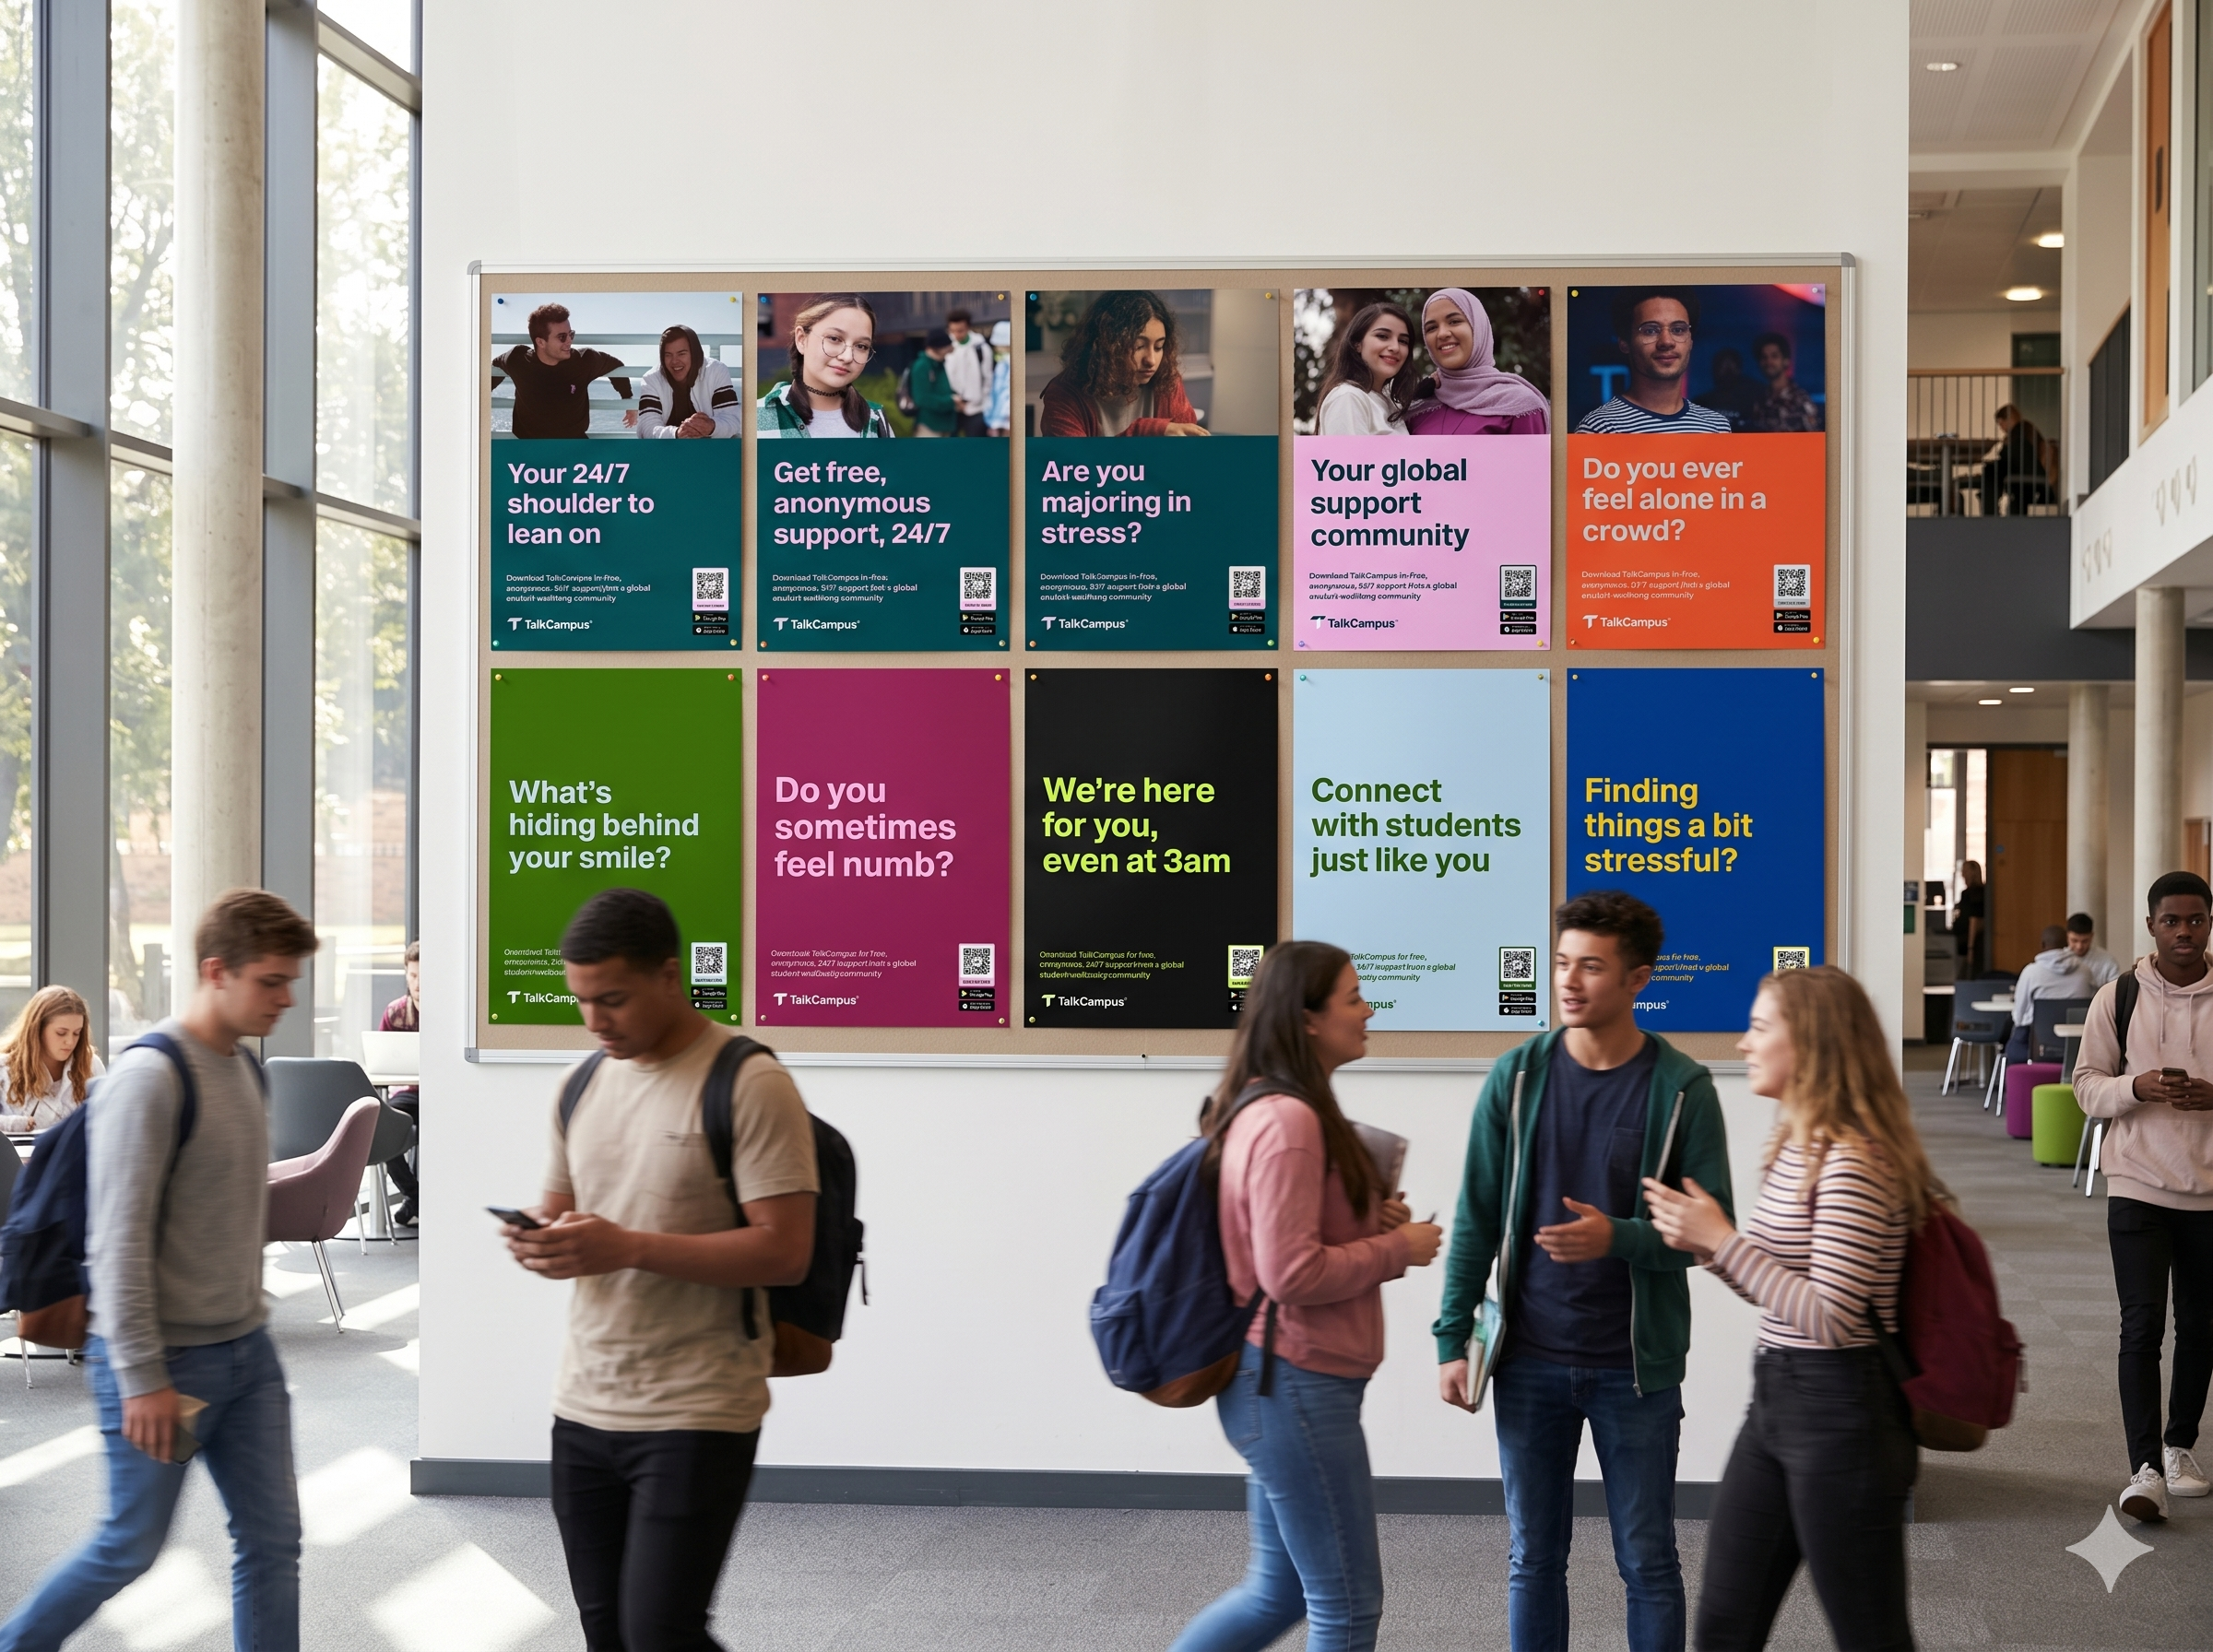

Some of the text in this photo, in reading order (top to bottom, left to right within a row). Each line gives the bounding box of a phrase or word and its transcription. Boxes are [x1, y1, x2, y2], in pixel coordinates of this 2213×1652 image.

[507, 463, 630, 484] Your 24/7
[775, 461, 886, 487] Get free,
[1042, 461, 1144, 488] Are you
[1311, 458, 1466, 487] Your global
[1584, 457, 1743, 485] Do you ever
[508, 493, 654, 513] shoulder to
[774, 497, 930, 519] anonymous
[1043, 490, 1190, 518] majoring in
[1310, 492, 1421, 519] support
[1582, 488, 1766, 510] feel alone in a
[508, 524, 600, 544] lean on
[774, 523, 951, 549] support, 24/7
[1042, 522, 1142, 544] stress?
[1310, 523, 1470, 551] community
[1583, 519, 1686, 541] crowd?
[574, 595, 616, 603] community
[627, 584, 650, 593] global
[893, 584, 917, 593] global
[1109, 594, 1152, 602] community
[1378, 593, 1421, 601] community
[1433, 583, 1457, 591] global
[509, 780, 611, 804] What’s
[776, 777, 885, 809] Do you
[1043, 777, 1214, 803] We’re here
[1312, 777, 1442, 803] Connect
[1585, 777, 1698, 810] Finding
[510, 813, 698, 842] hiding behind
[775, 813, 956, 841] sometimes
[1042, 811, 1157, 844] for you,
[1310, 811, 1521, 837] with students
[1584, 811, 1753, 844] things a bit
[509, 845, 670, 874] your smile?
[775, 850, 953, 877] feel numb?
[1043, 848, 1230, 873] even at 3am
[1310, 847, 1489, 879] just like you
[1585, 846, 1738, 873] stressful?
[1161, 962, 1185, 970] global
[1410, 953, 1426, 962] free,
[1108, 972, 1151, 980] community
[1651, 974, 1694, 983] community
[524, 993, 579, 1005] TalkCamp
